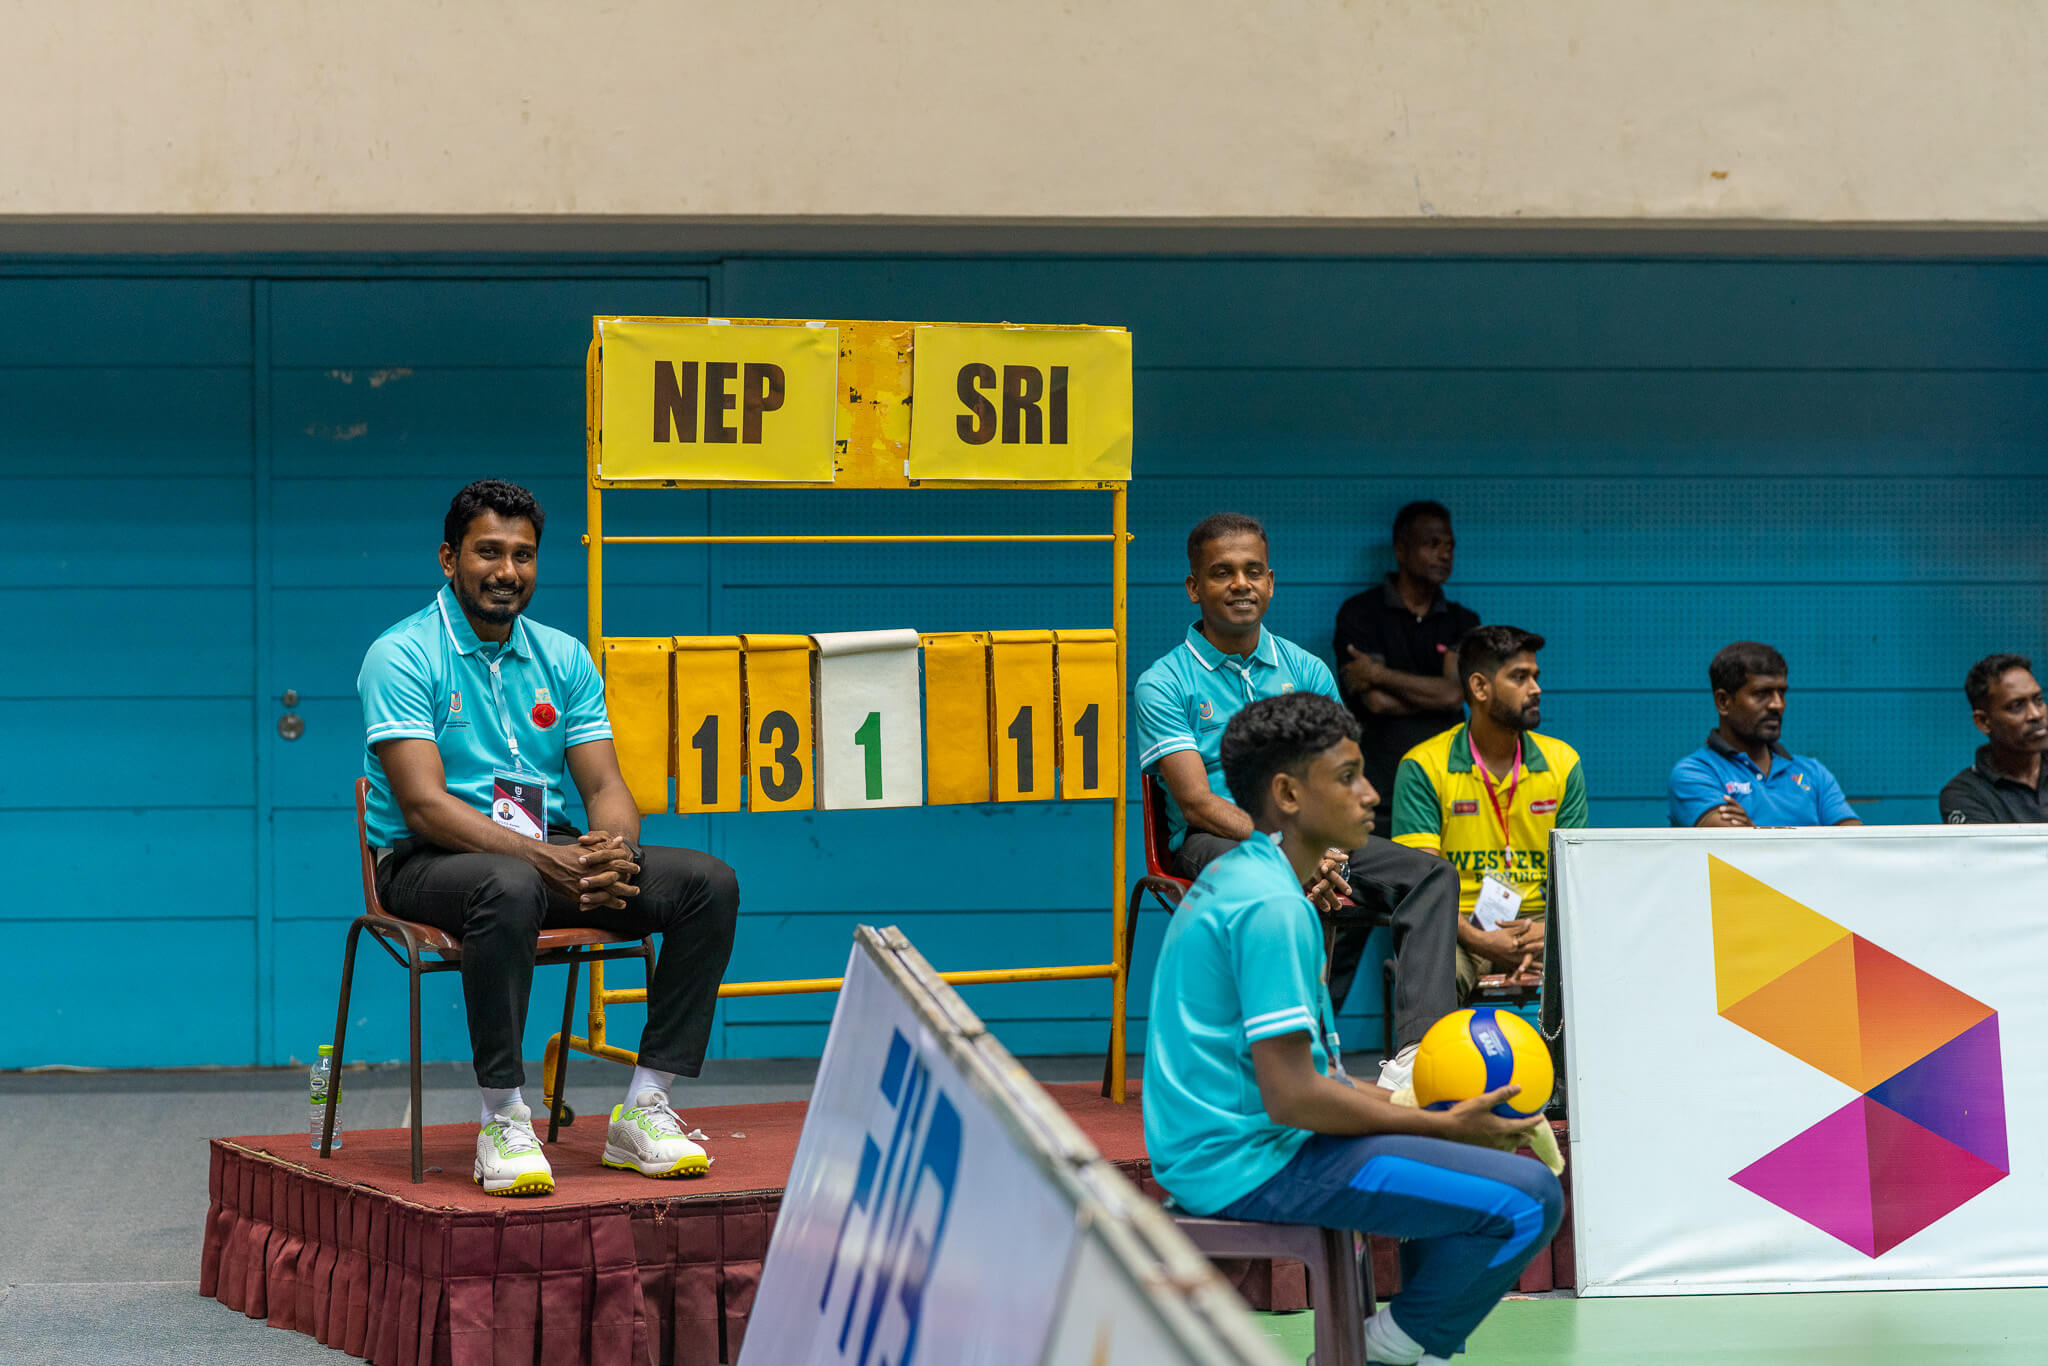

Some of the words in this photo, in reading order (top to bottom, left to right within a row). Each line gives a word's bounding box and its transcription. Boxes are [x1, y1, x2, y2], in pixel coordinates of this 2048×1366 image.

[652, 360, 786, 445] NEP
[956, 362, 1070, 446] SRI
[854, 711, 883, 801] 1
[1446, 850, 1549, 871] WESTER
